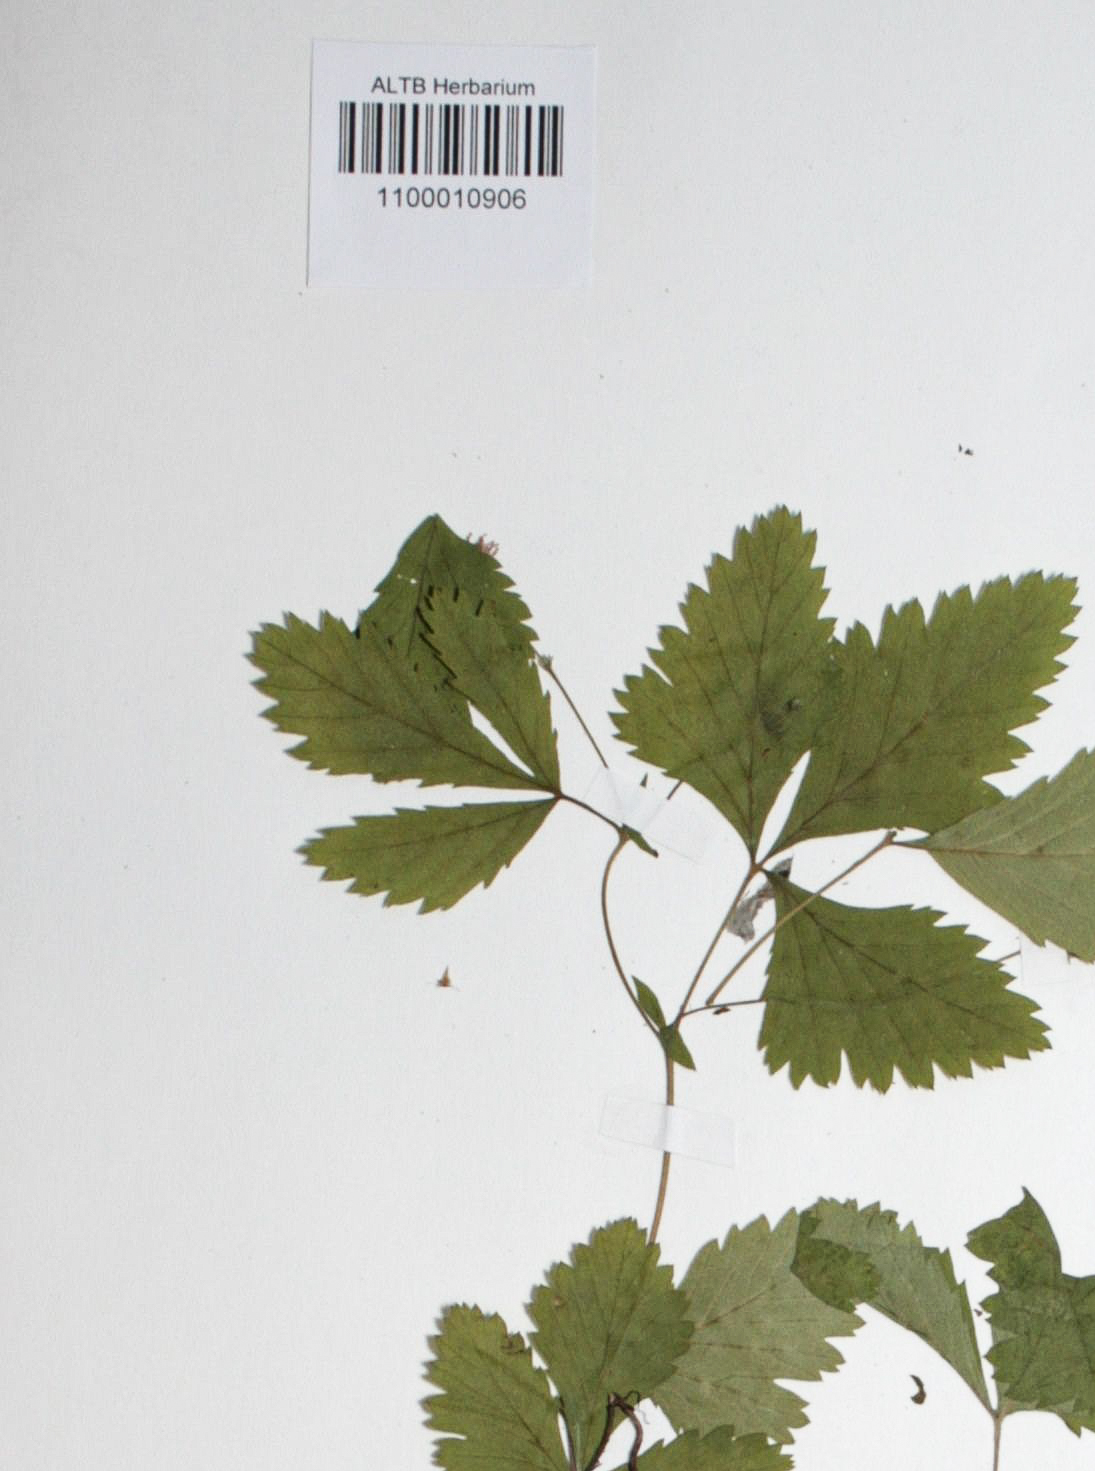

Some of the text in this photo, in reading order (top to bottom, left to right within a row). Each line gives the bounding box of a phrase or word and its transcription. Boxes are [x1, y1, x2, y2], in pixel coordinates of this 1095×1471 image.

[371, 76, 536, 96] ALTB Herbarium
[378, 187, 527, 209] 1100010906
